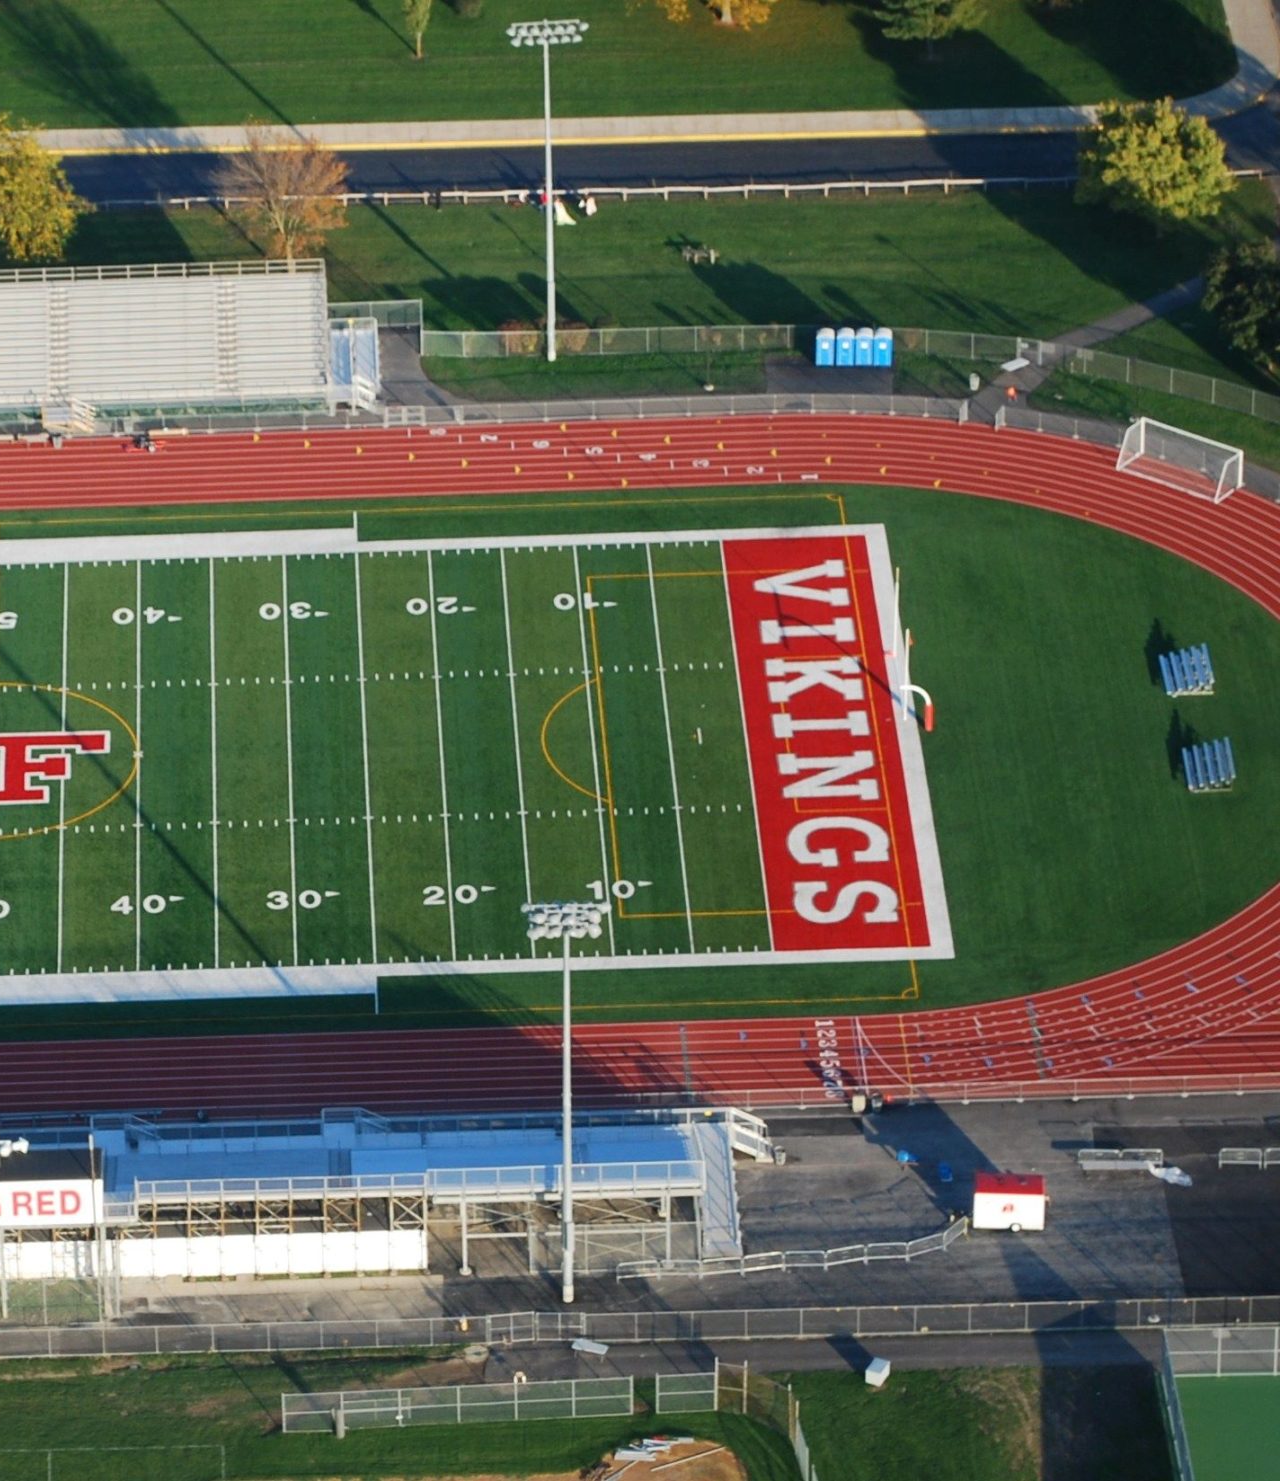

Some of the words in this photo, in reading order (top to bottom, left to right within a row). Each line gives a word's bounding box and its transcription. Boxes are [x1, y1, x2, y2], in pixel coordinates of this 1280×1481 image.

[429, 428, 447, 436] 8
[480, 434, 498, 443] 7
[532, 440, 550, 449] 6
[585, 446, 603, 456] 5
[639, 453, 656, 461] 4
[692, 459, 710, 468] 3
[746, 466, 764, 475] 2
[259, 601, 312, 620] 30
[406, 596, 458, 615] 20
[553, 592, 600, 611] 10
[112, 606, 165, 625] 40
[753, 559, 899, 924] VIKINGS
[423, 885, 478, 905] 20
[586, 879, 635, 899] 10
[110, 894, 166, 915] 40
[266, 890, 322, 910] 30
[12, 1190, 82, 1216] RED
